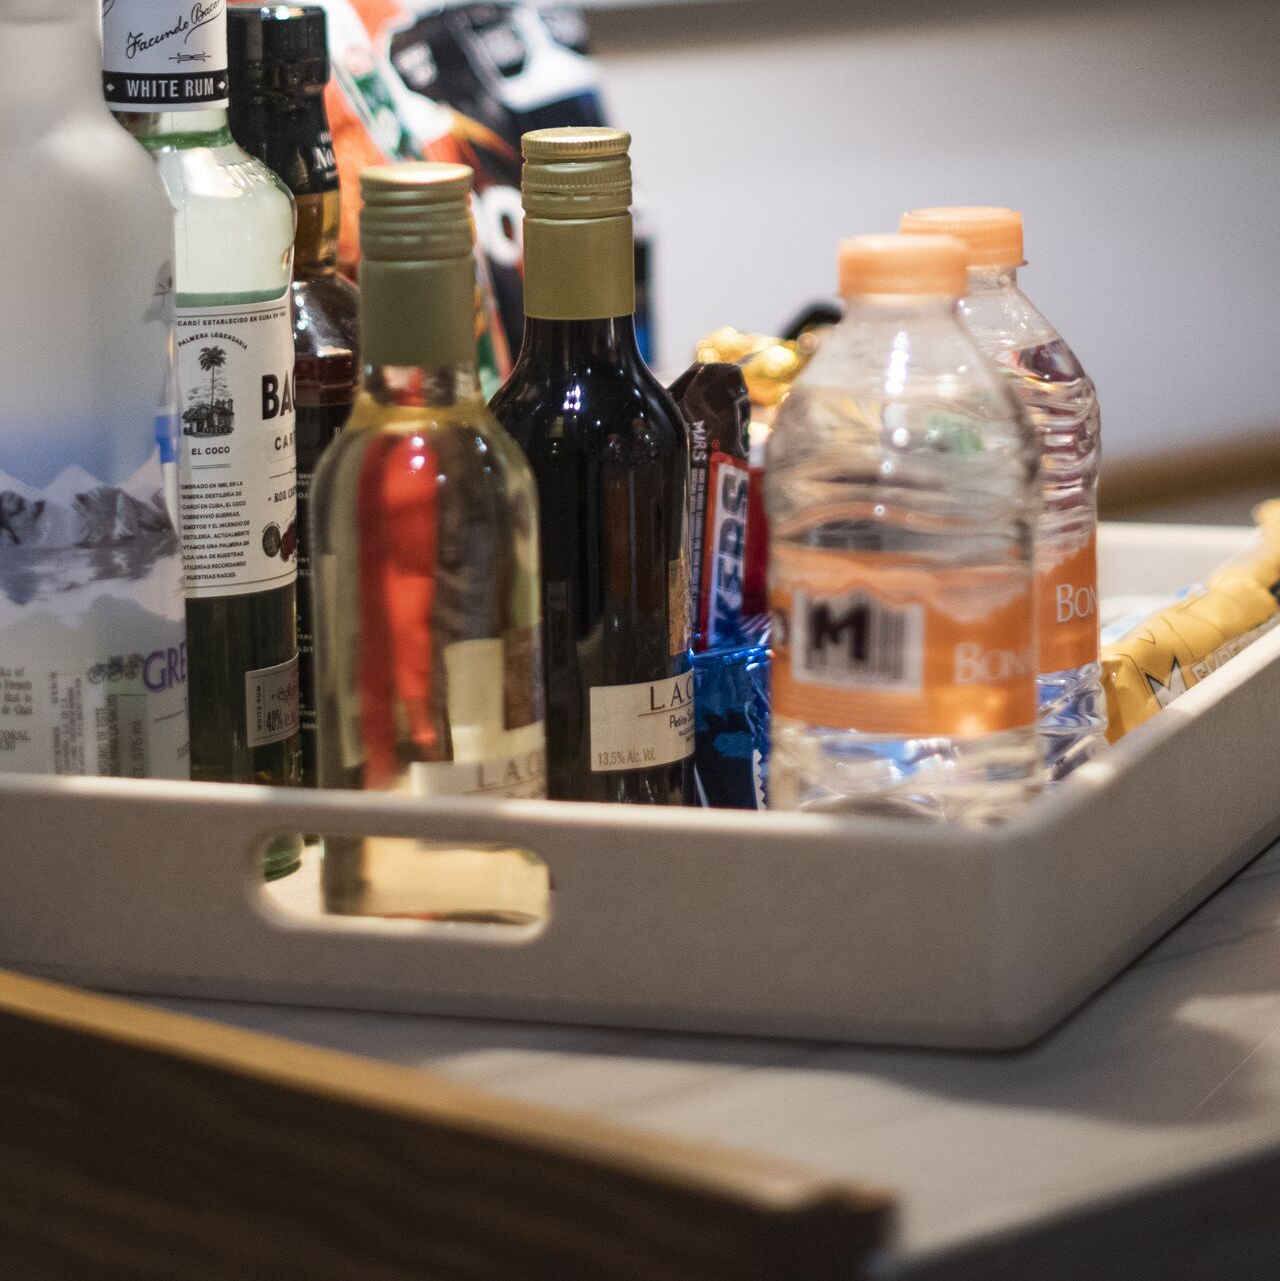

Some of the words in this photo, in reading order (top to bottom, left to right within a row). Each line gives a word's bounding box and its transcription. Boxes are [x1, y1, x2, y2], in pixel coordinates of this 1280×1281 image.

[125, 15, 190, 59] Facundo
[126, 79, 179, 98] WHITE
[185, 77, 214, 96] RUM
[202, 316, 248, 326] ESTABLECIDO
[178, 332, 208, 347] PALMERA
[692, 420, 707, 461] MARS
[191, 447, 202, 456] EL
[205, 445, 231, 455] COCO
[597, 750, 625, 768] 13,5%
